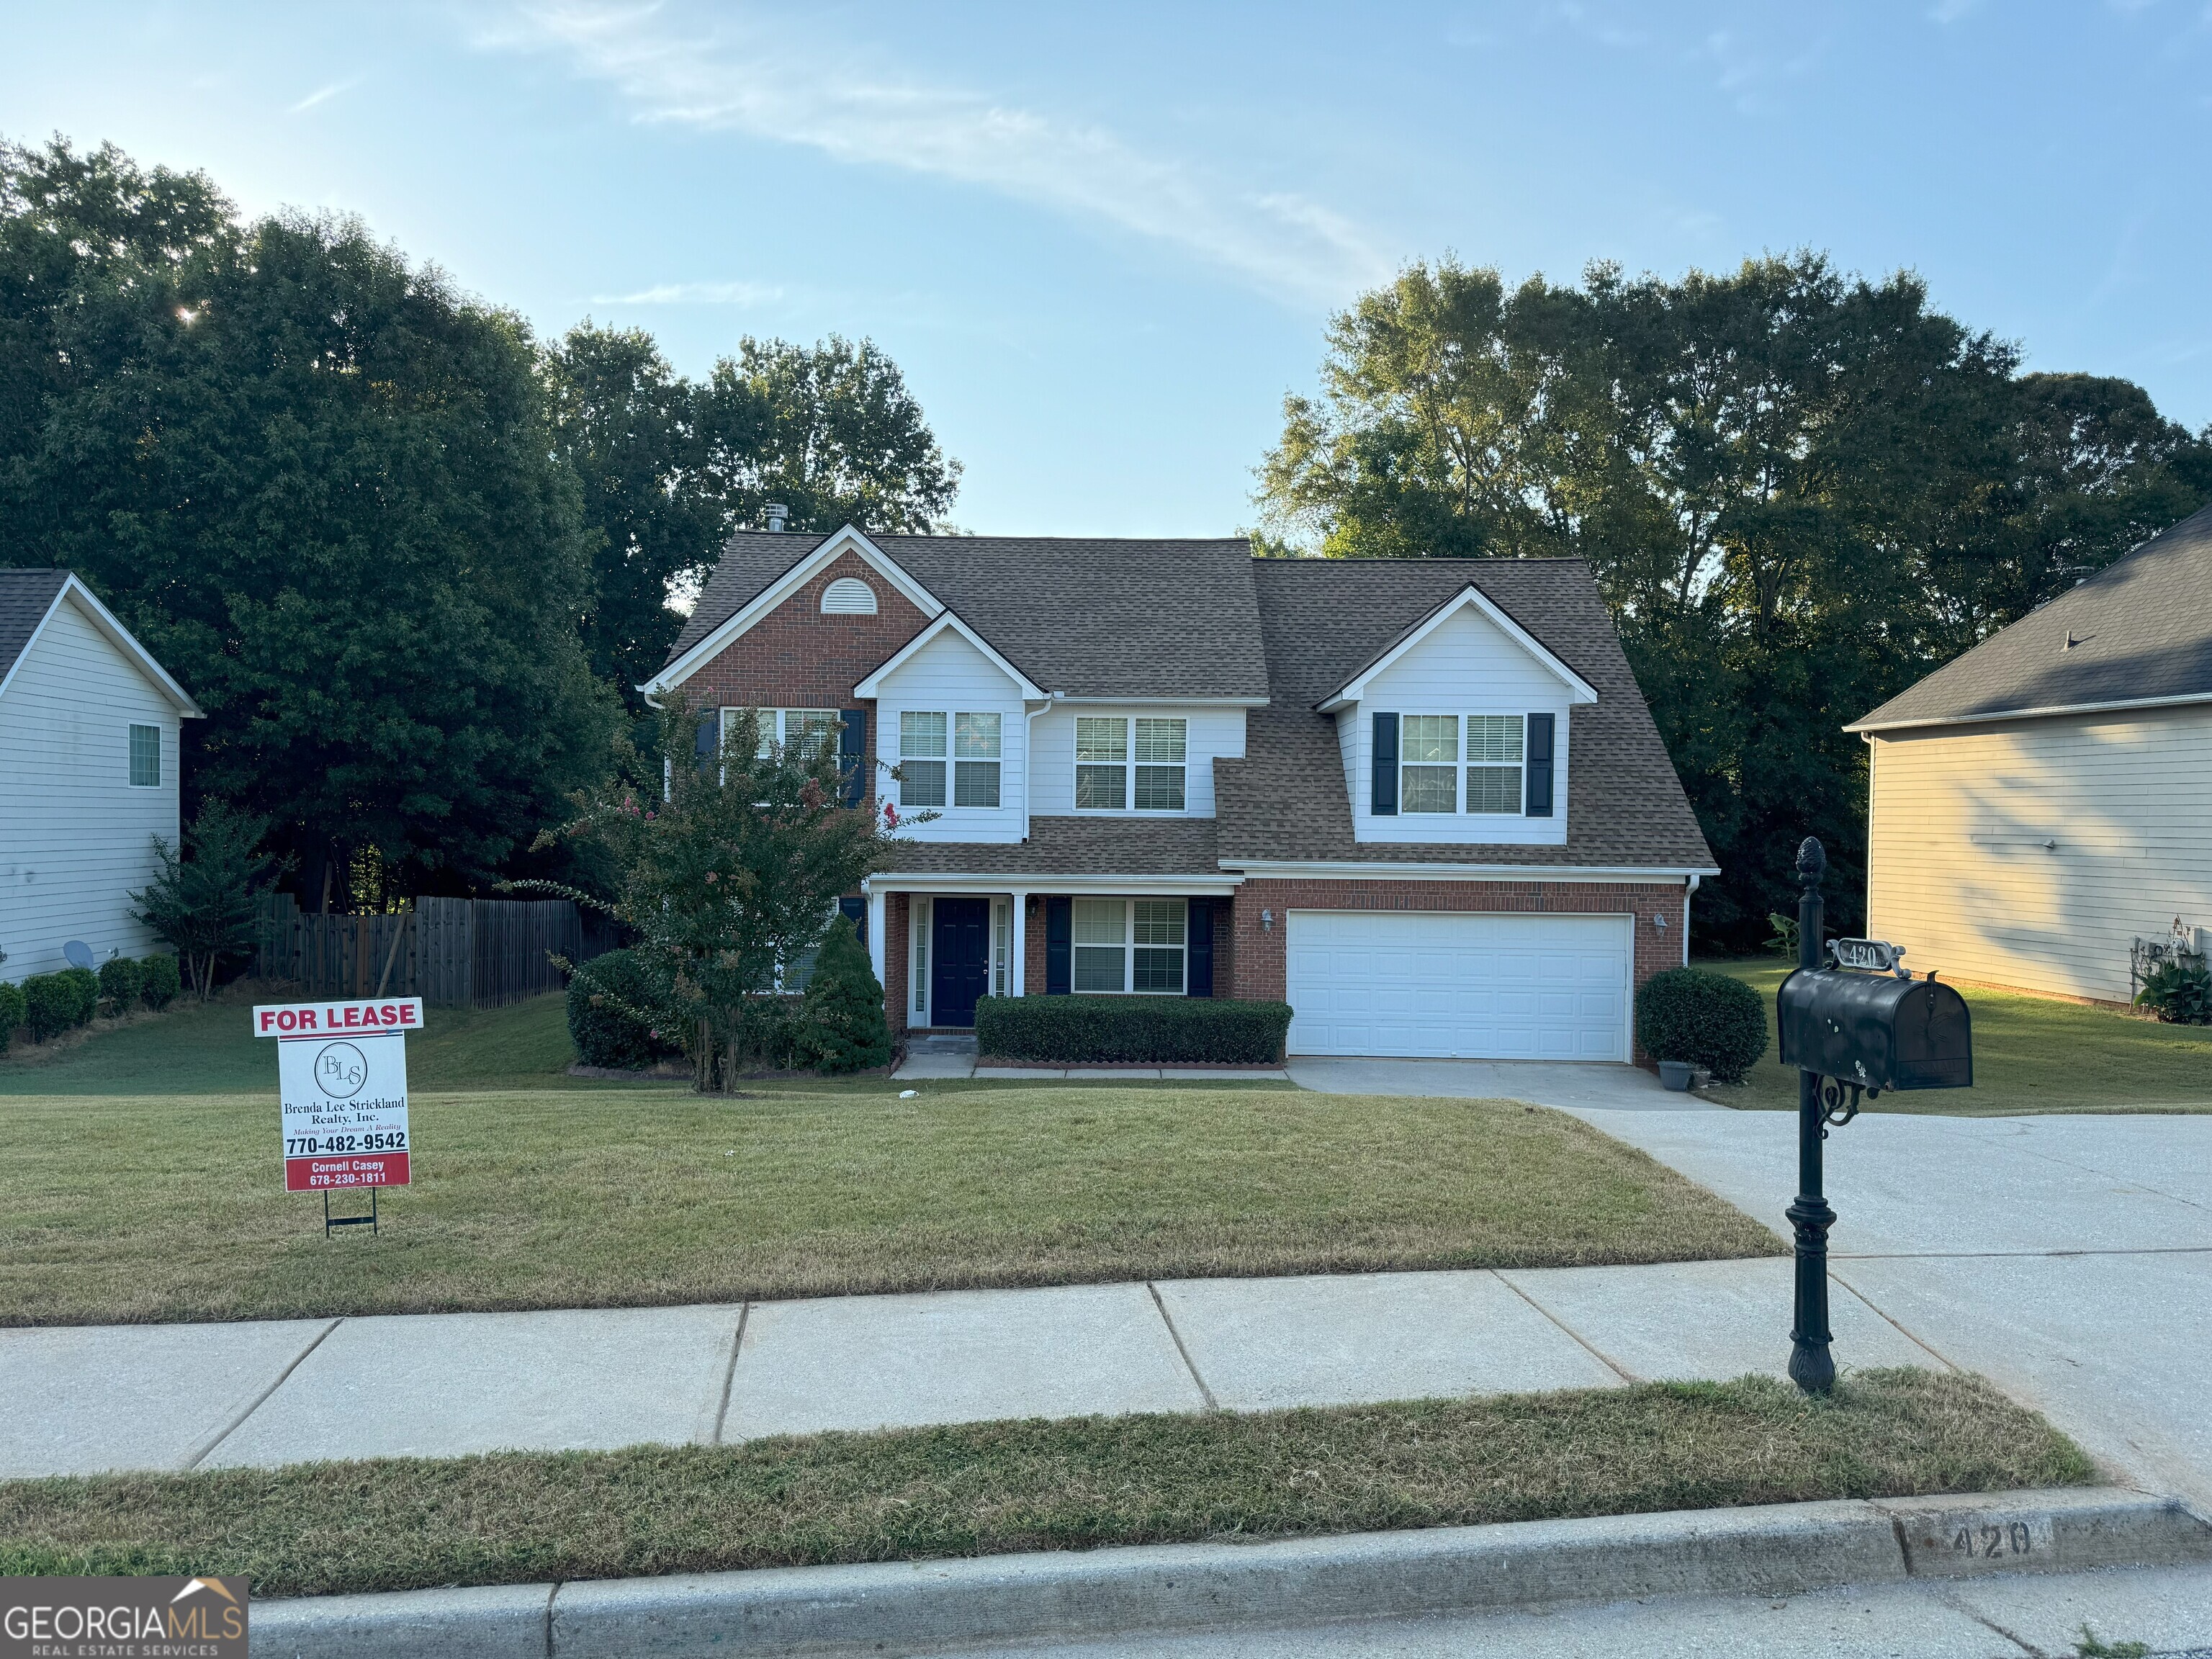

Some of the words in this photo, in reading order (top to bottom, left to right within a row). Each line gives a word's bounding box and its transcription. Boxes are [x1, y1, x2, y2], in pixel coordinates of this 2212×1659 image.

[1849, 945, 1876, 966] 420
[260, 1010, 317, 1031] FOR
[327, 1004, 416, 1028] LEASE
[323, 1056, 361, 1085] BLS
[284, 1102, 323, 1114] Brenda
[326, 1101, 346, 1112] Lee
[349, 1097, 405, 1111] Strickland
[311, 1115, 351, 1125] Realty,
[356, 1112, 379, 1122] Inc.
[287, 1133, 405, 1154] 770-482-9542
[312, 1161, 349, 1172] Cornell
[352, 1160, 384, 1172] Casey
[310, 1172, 386, 1185] 678-230-1811
[1953, 1521, 2031, 1559] 420
